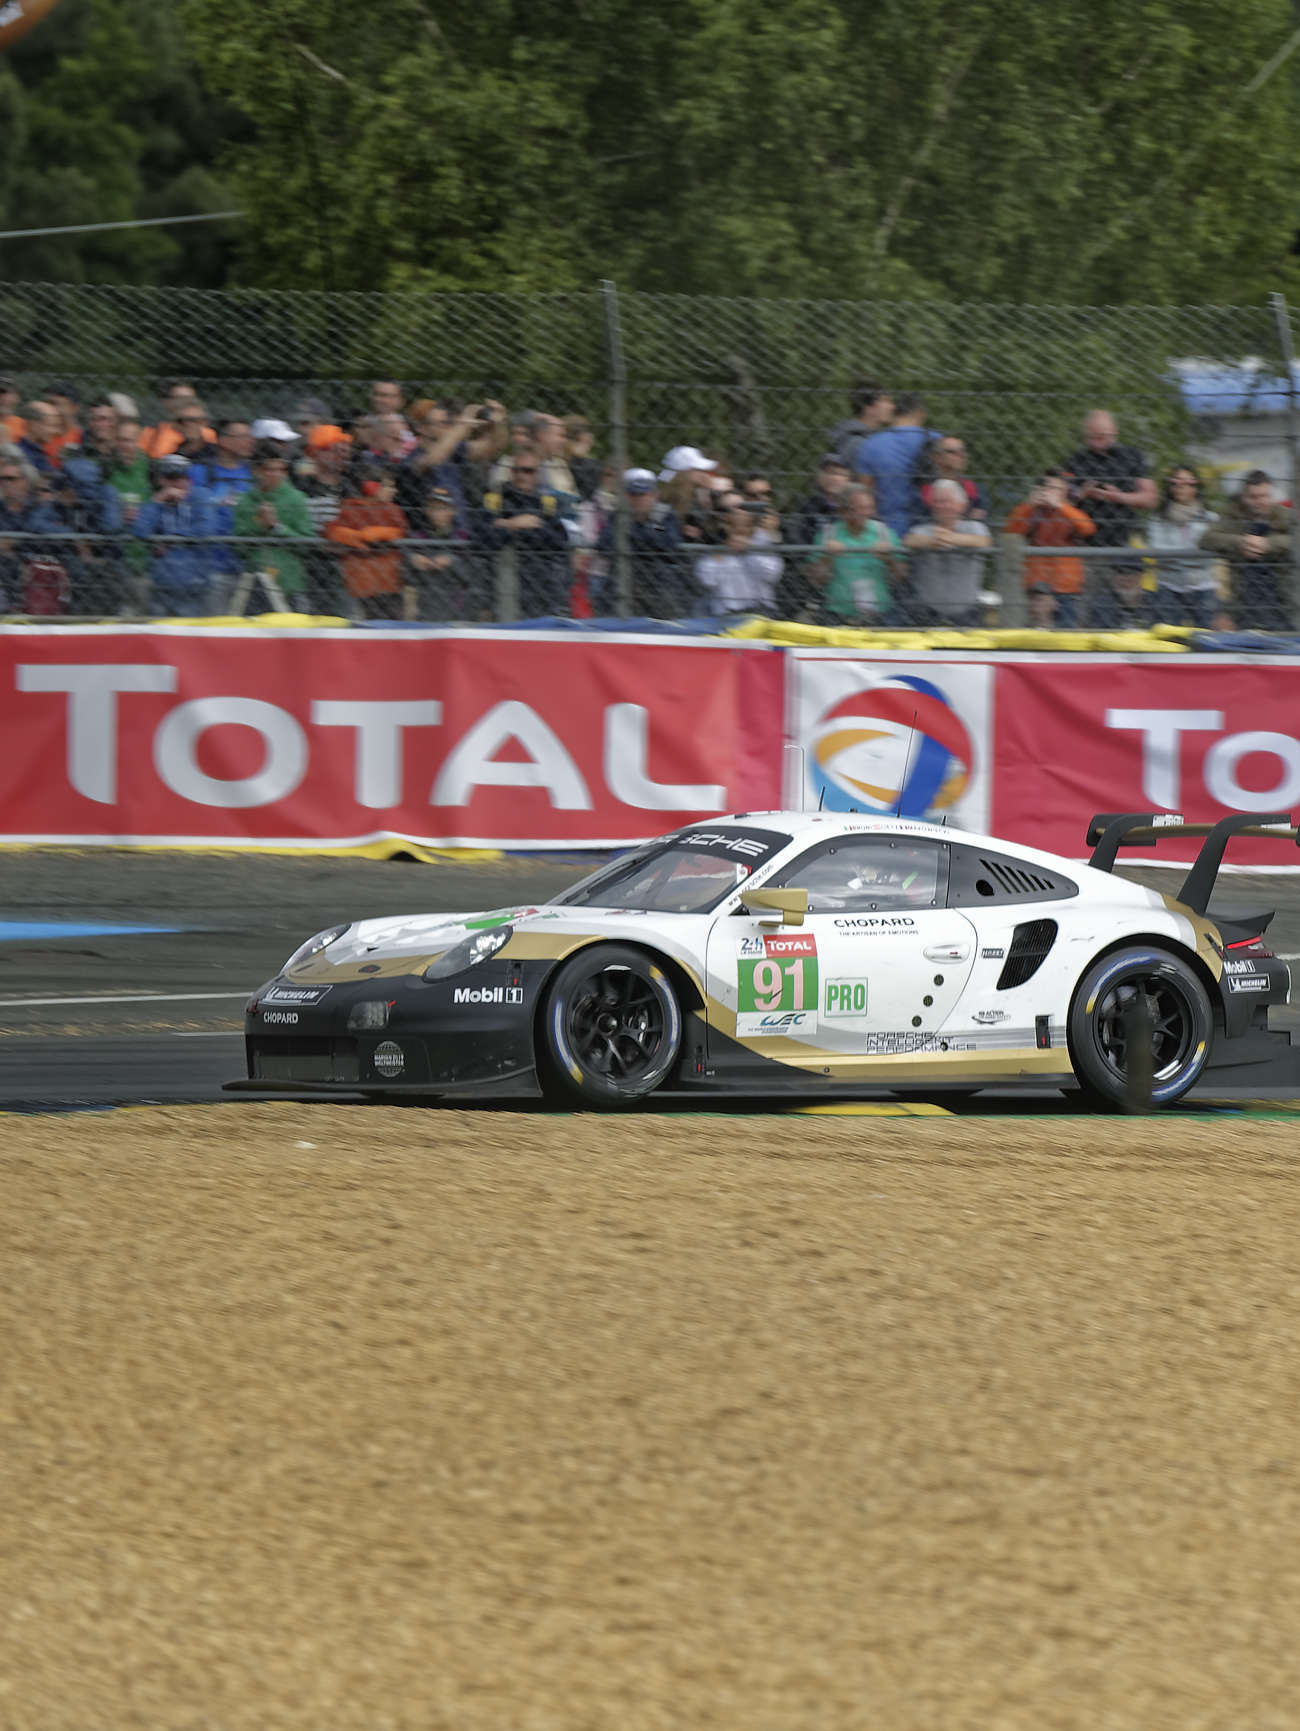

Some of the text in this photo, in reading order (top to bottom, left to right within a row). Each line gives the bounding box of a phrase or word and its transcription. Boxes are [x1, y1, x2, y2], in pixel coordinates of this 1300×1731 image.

[15, 663, 727, 811] TOTAL
[833, 917, 915, 928] CHOPARD
[768, 940, 812, 951] TOTAL
[1223, 960, 1247, 974] Mobil
[753, 958, 804, 1011] 91
[274, 990, 320, 1000] MICHELIN
[454, 987, 502, 1004] Mobil
[827, 983, 865, 1011] PRO
[263, 1012, 299, 1024] CHOPARD
[760, 1013, 806, 1026] WEC
[867, 1031, 934, 1040] PORSCHE
